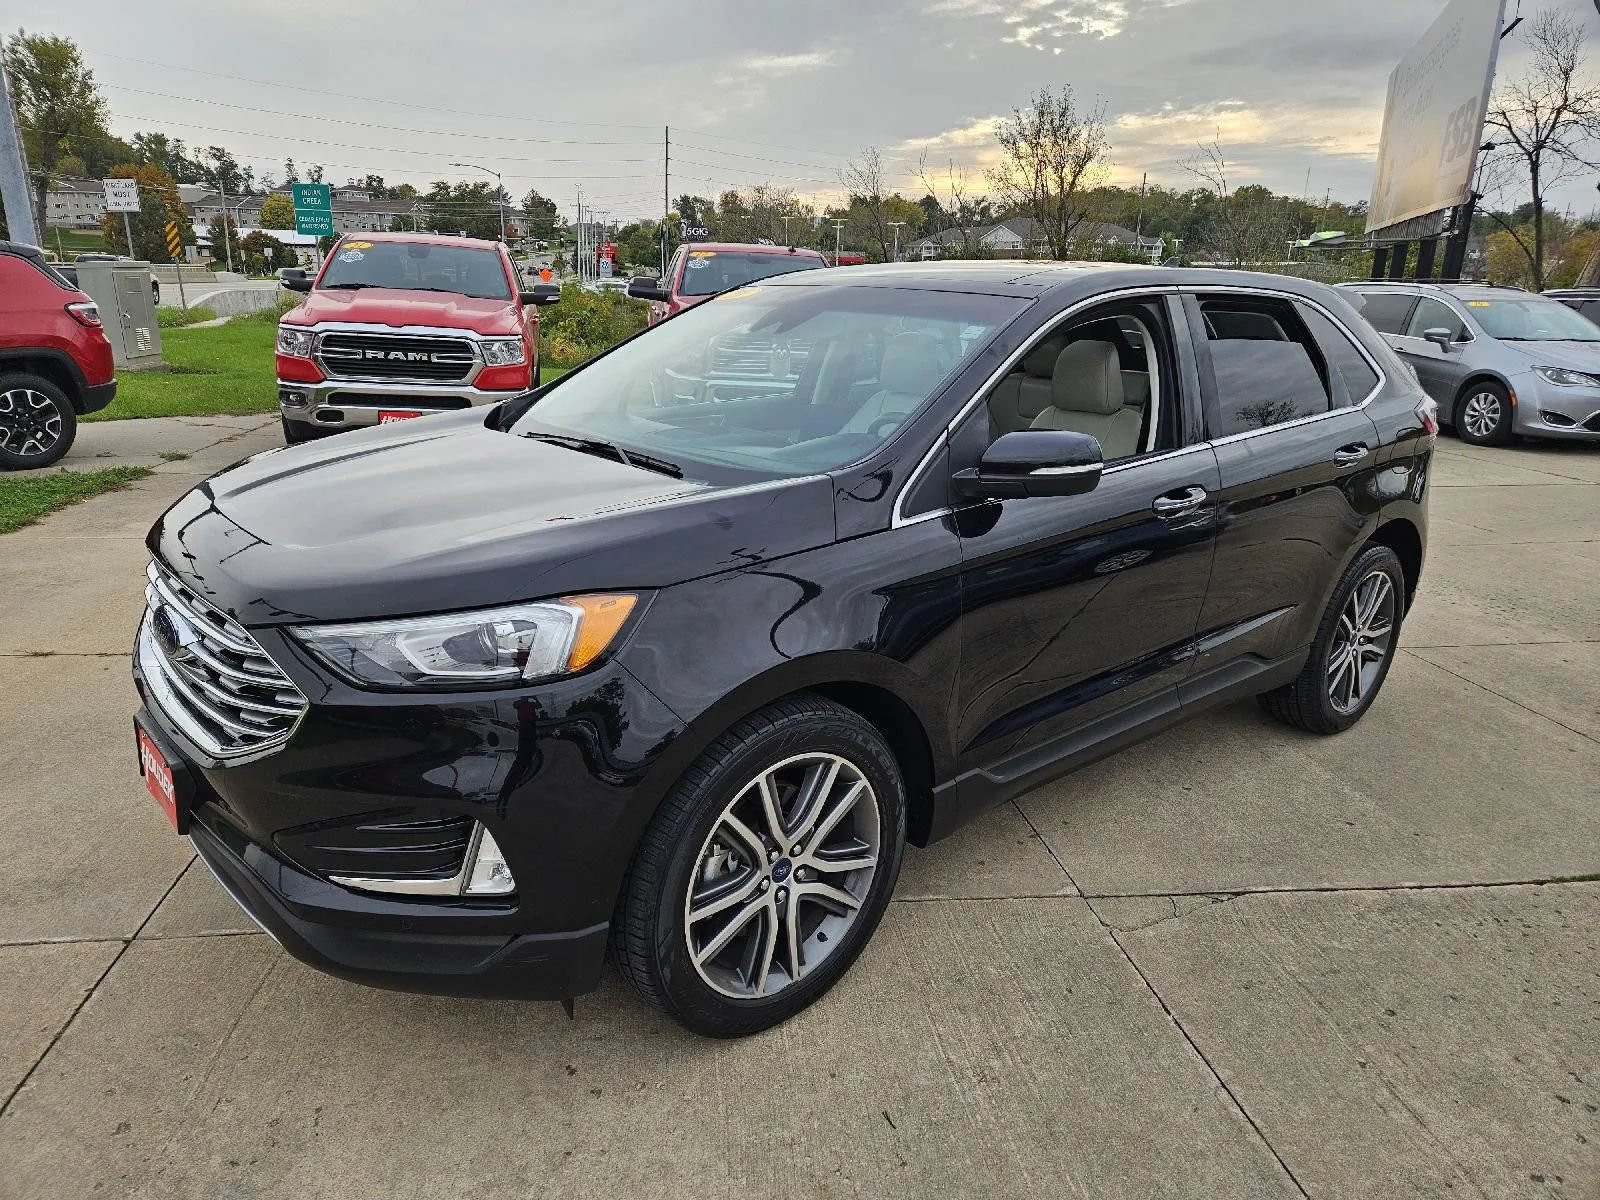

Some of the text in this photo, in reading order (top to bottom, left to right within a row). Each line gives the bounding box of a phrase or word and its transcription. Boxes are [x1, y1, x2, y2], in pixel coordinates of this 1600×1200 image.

[112, 190, 131, 198] MUST
[301, 189, 322, 197] INDIAN
[302, 197, 322, 205] CREEK
[365, 350, 428, 361] RAM
